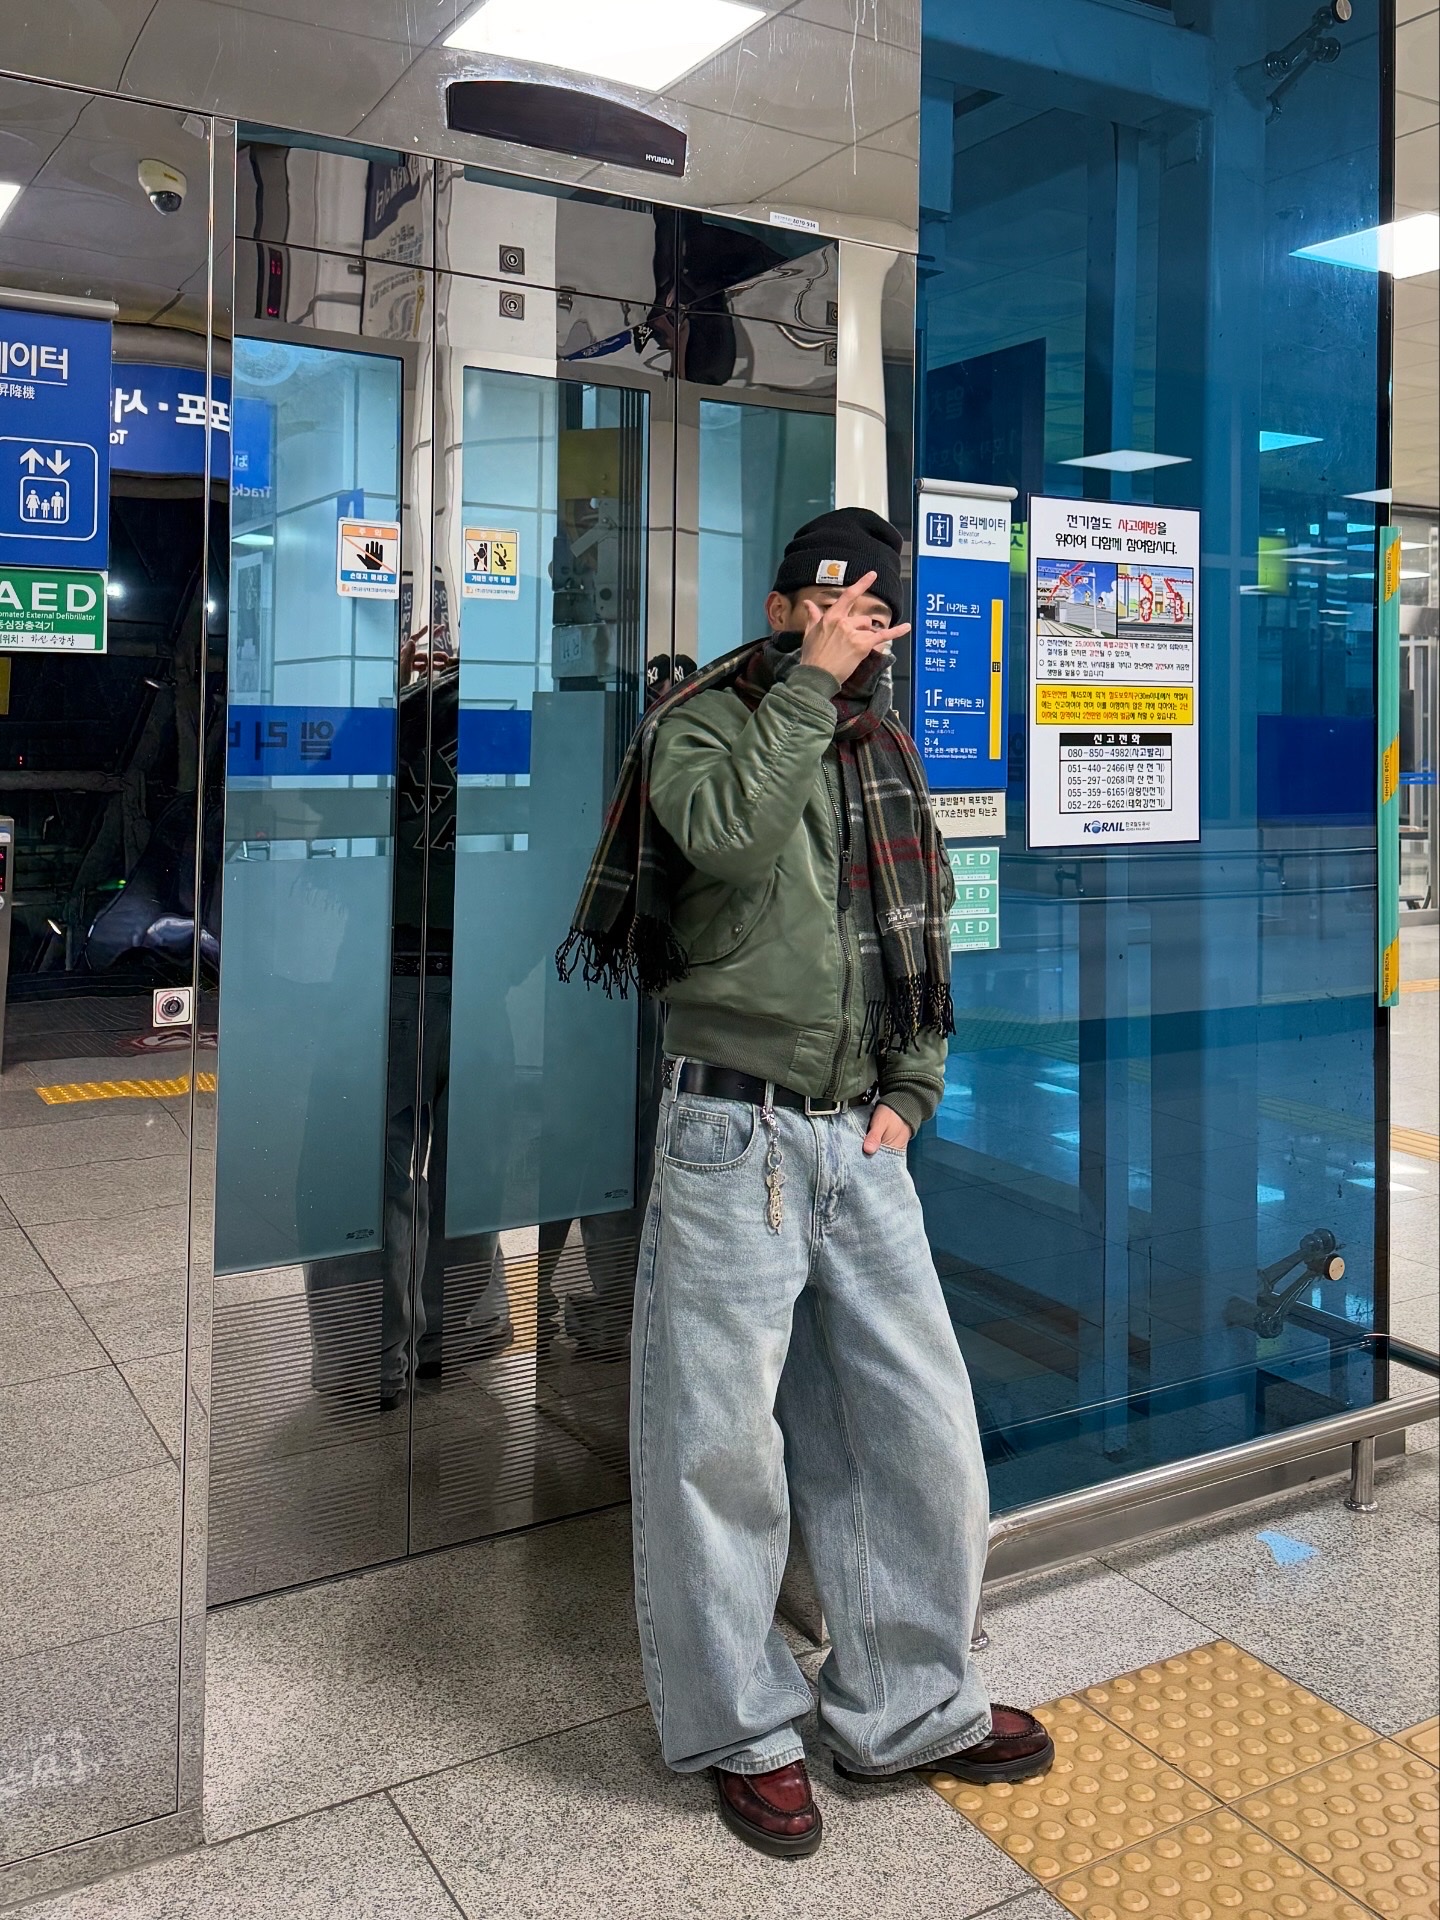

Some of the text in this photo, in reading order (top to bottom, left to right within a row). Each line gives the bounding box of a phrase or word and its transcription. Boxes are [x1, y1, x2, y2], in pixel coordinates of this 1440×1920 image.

[645, 154, 675, 166] HYUNDAI
[0, 342, 68, 379] 이터
[959, 515, 1006, 532] 엘리베이터
[1066, 514, 1167, 535] 전기철도 사고예방을
[958, 529, 980, 537] Elevator
[1055, 532, 1178, 554] 위하여 다함께 참여합시다.
[350, 572, 368, 581] 손대지
[0, 580, 97, 612] AED
[926, 593, 980, 614] 3F (나가는 곳)
[26, 611, 55, 619] External
[56, 612, 96, 621] Defibrillator
[925, 619, 947, 630] 역무실
[925, 638, 947, 648] 맞이방
[925, 657, 957, 668] 표사는 곳
[924, 689, 984, 708] 1F (열차타는 곳)
[925, 718, 950, 728] 타는 곳
[939, 796, 966, 807] 일반열차
[968, 795, 994, 806] 목포방면
[935, 808, 976, 818] KTX순천방면
[951, 853, 991, 866] AED
[950, 921, 990, 934] AED
